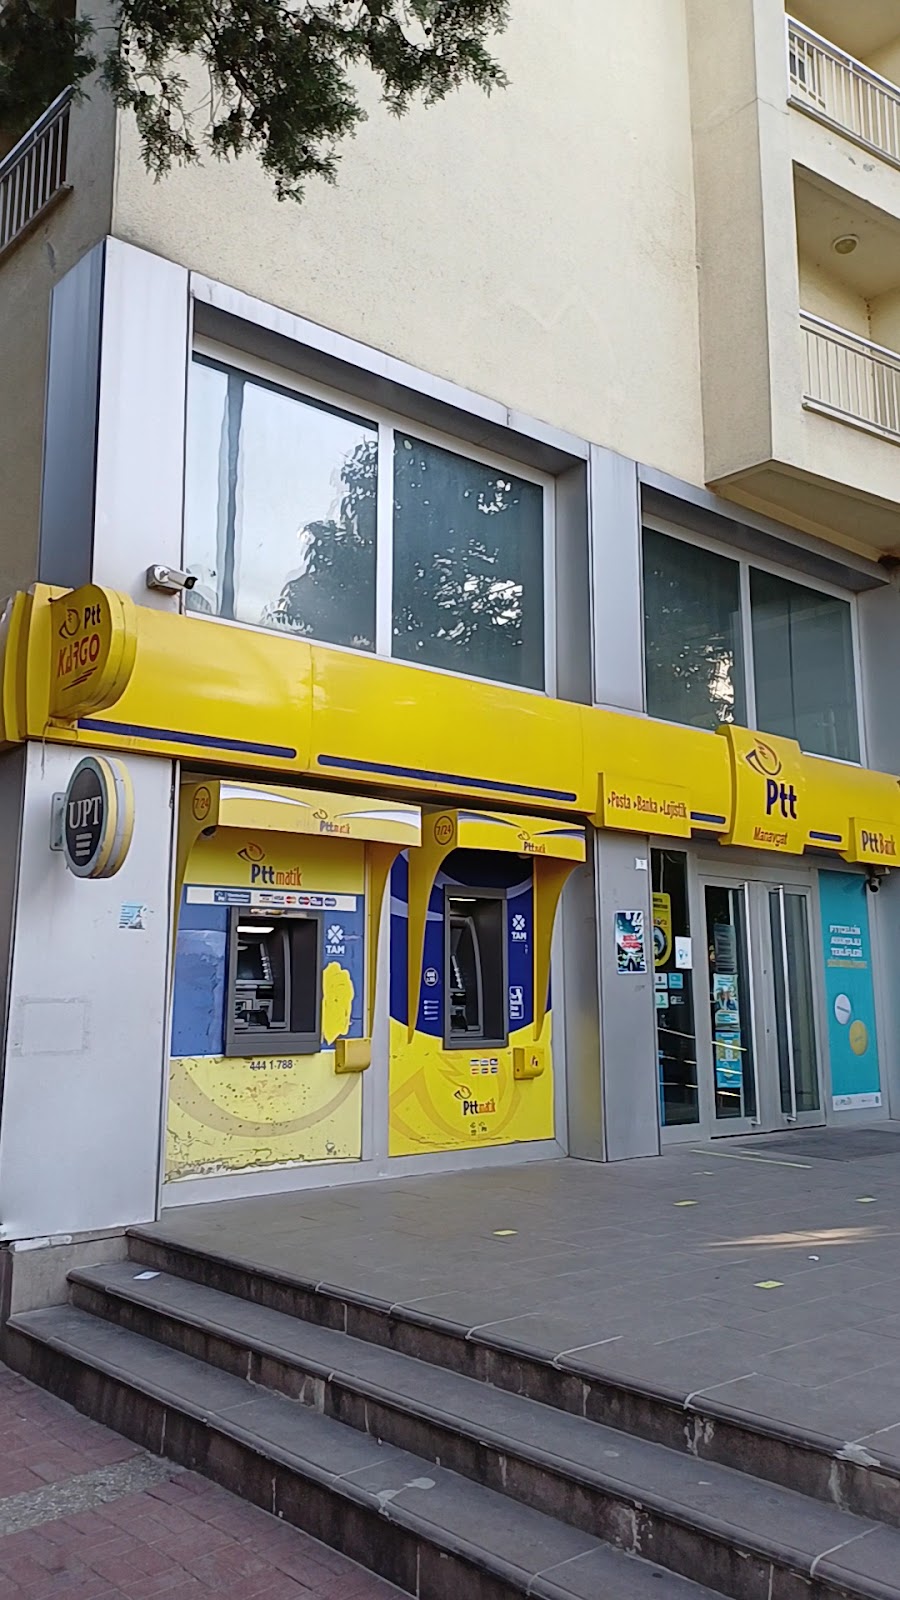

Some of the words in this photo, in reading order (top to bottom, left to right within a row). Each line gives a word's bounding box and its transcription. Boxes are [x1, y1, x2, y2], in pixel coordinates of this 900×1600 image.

[84, 603, 101, 629] Ptt
[611, 791, 631, 809] Posta
[637, 795, 657, 813] Banka
[766, 778, 797, 820] Ptt
[68, 795, 102, 829] UPT
[511, 931, 527, 940] TAM
[325, 945, 345, 954] TAM
[250, 1060, 266, 1071] 444
